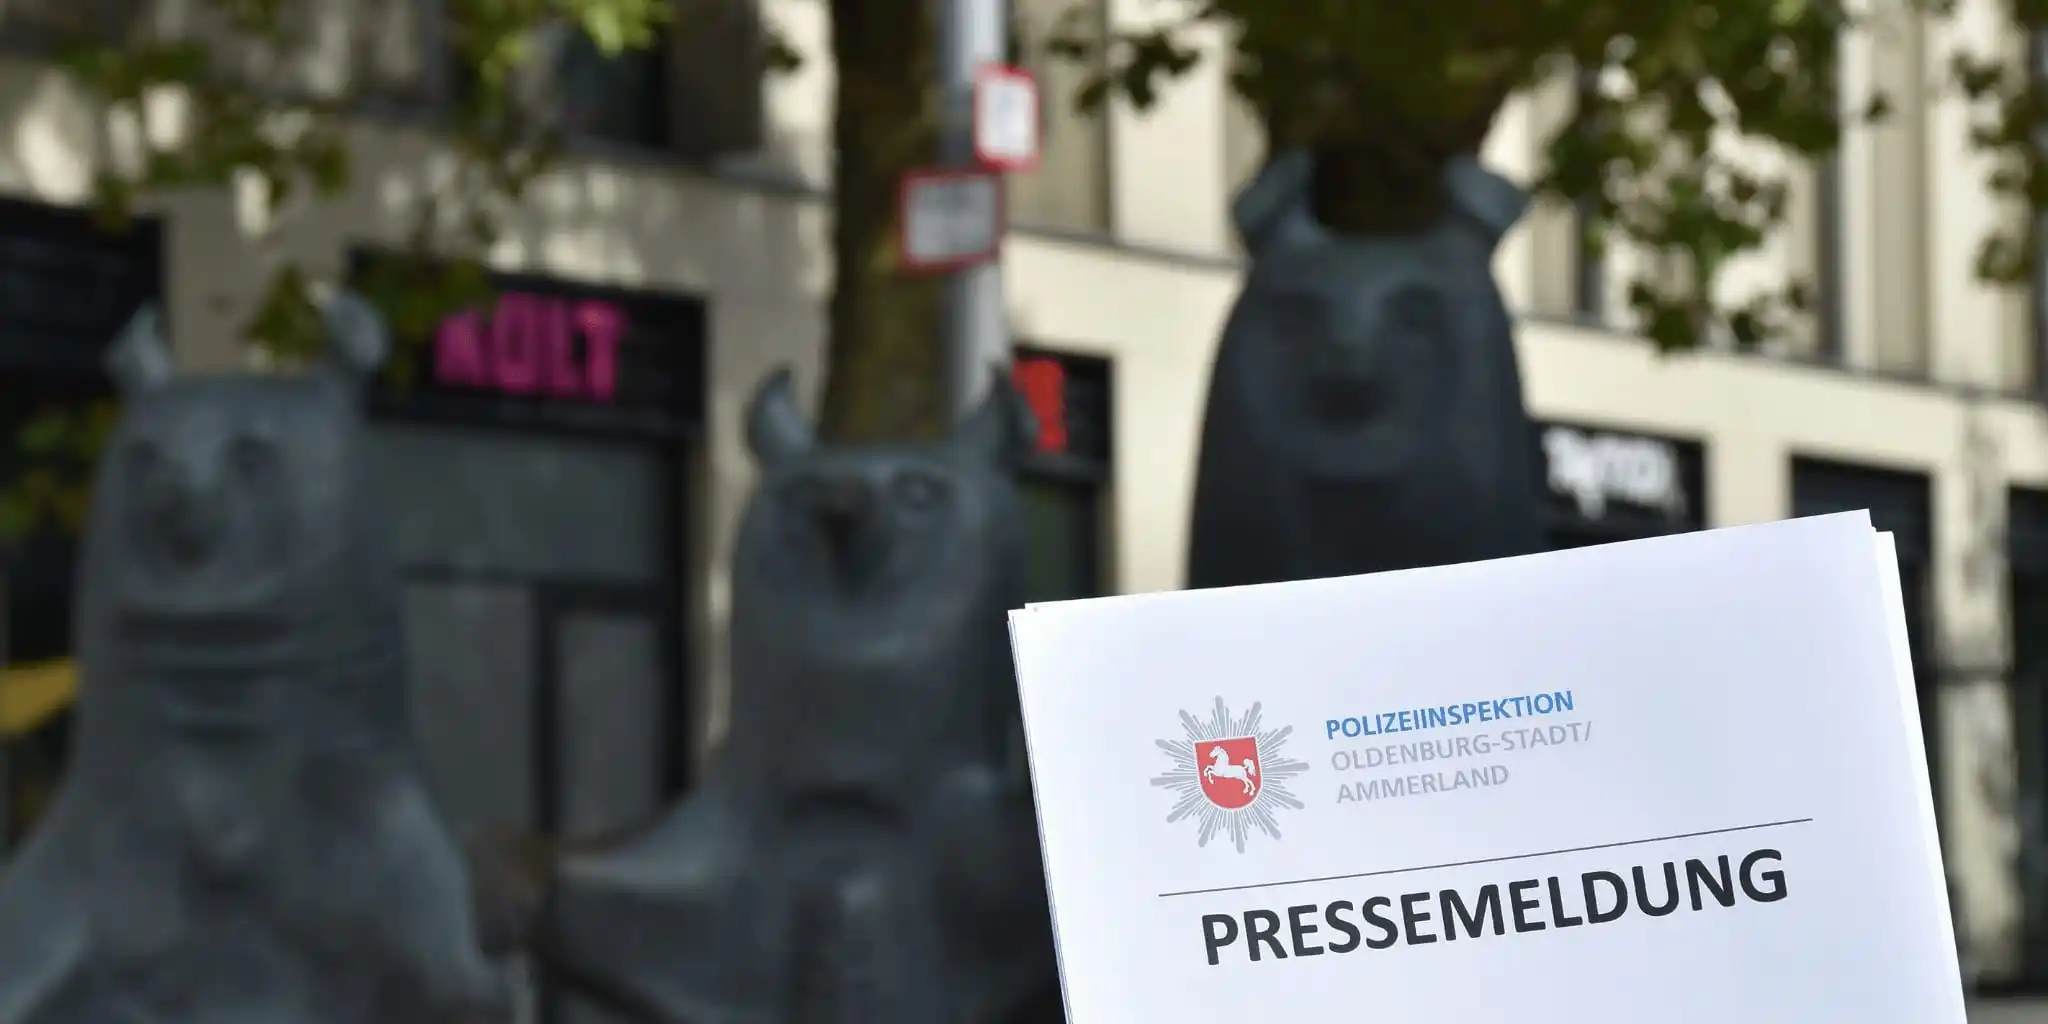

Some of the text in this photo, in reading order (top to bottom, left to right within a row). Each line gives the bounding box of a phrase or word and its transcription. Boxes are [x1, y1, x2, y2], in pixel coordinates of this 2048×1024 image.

[1326, 690, 1574, 740] POLIZEIINSPEKTION
[1331, 721, 1592, 771] OLDENBURG-STADT/
[1336, 765, 1510, 804] AMMERLAND
[1202, 848, 1788, 966] PRESSEMELDUNG
